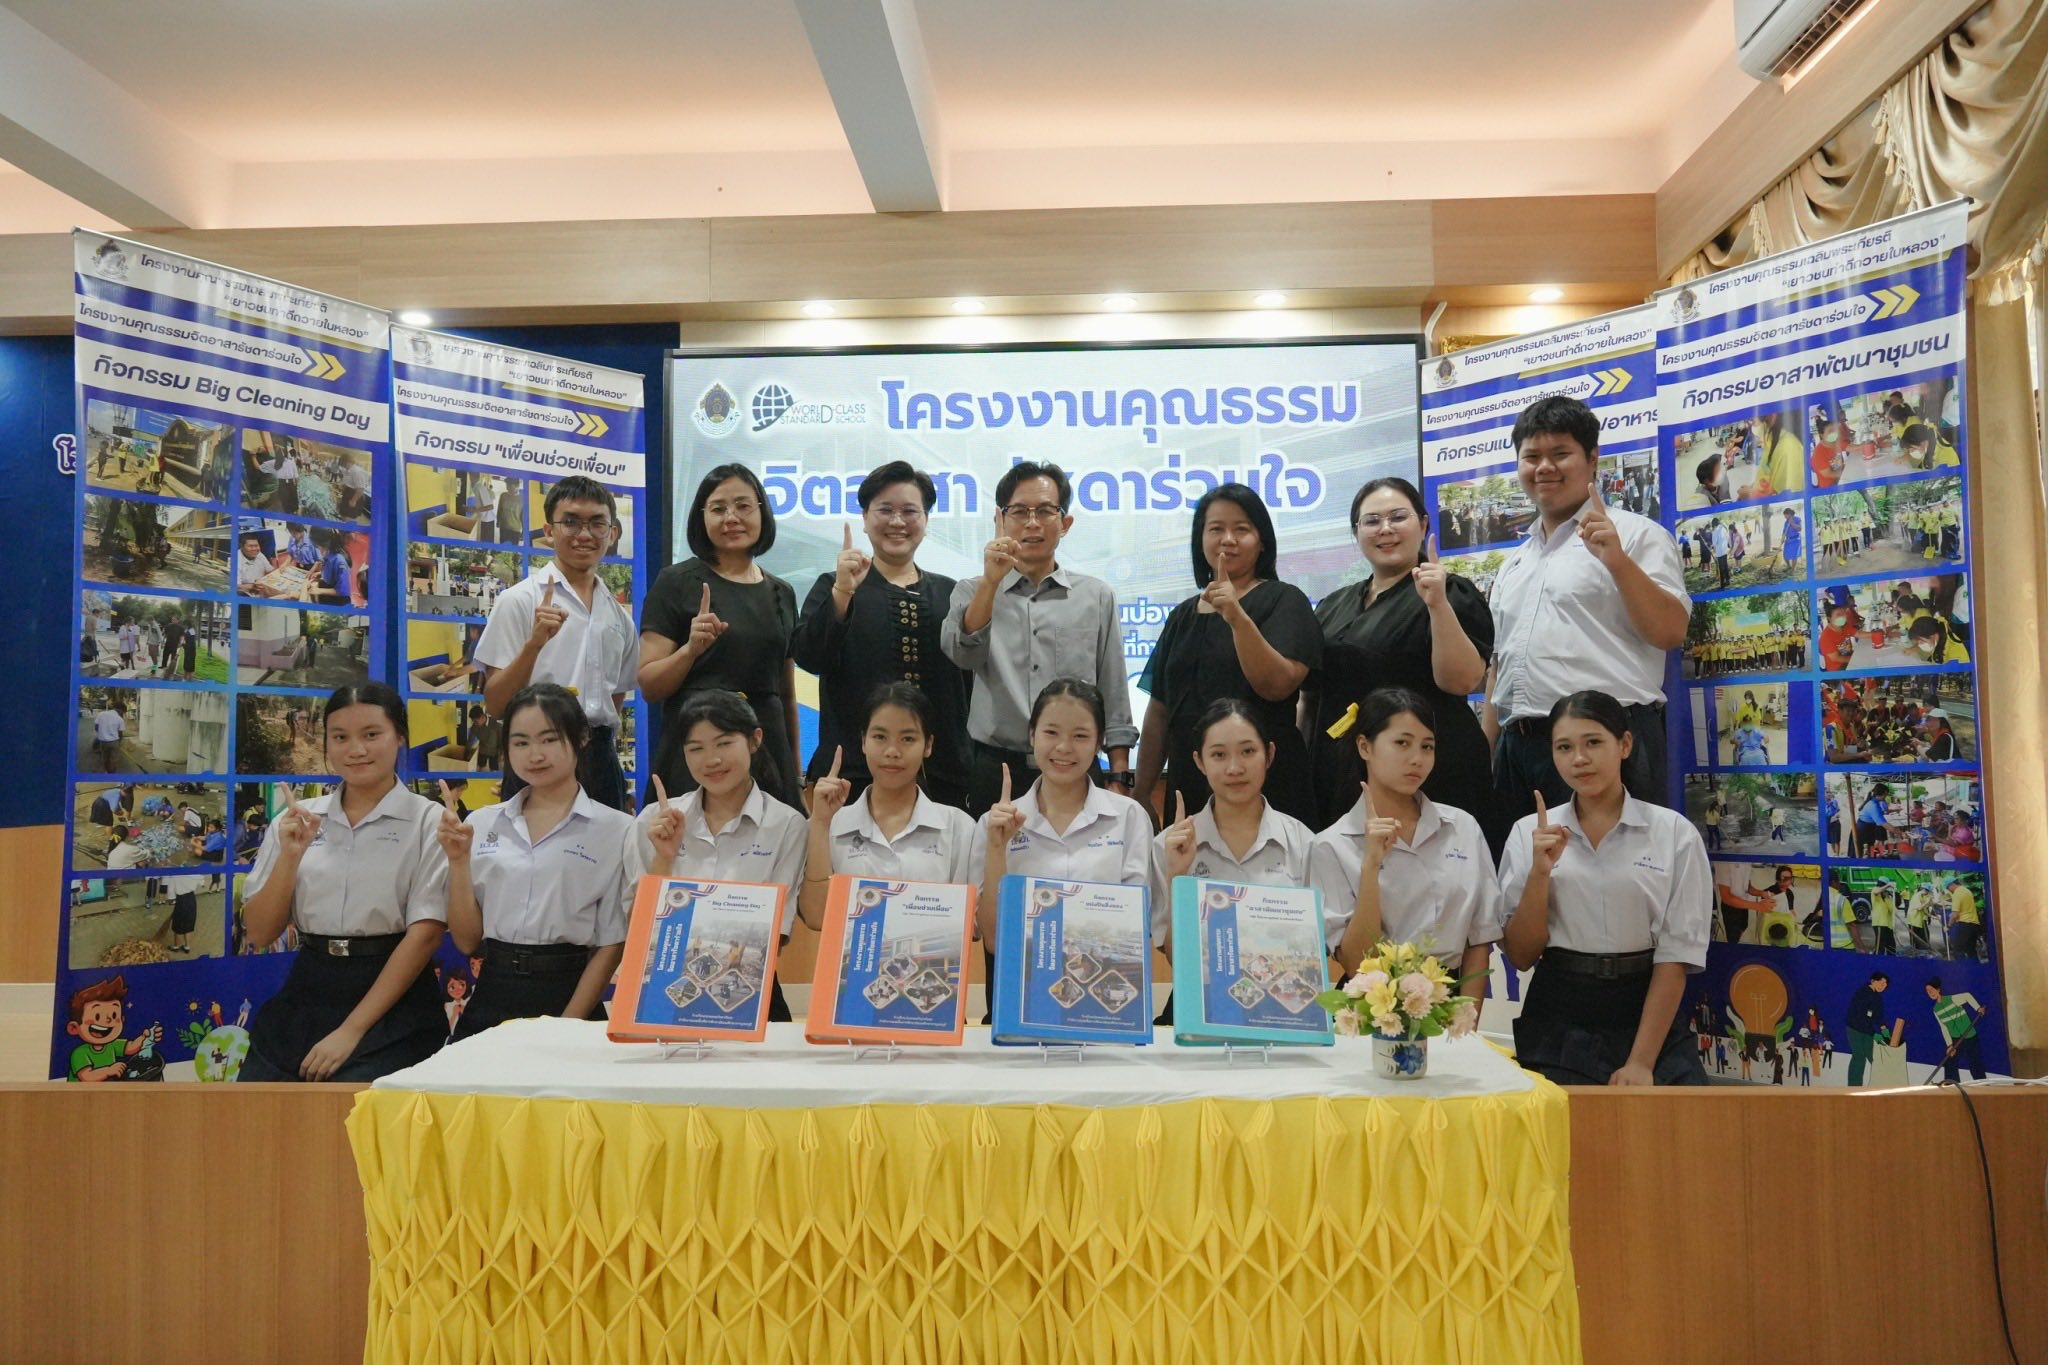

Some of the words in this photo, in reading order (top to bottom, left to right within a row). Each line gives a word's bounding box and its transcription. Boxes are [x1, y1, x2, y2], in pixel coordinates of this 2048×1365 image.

[93, 354, 190, 391] กิจกรรม
[195, 376, 230, 401] Big
[235, 387, 326, 422] Cleaning
[330, 404, 371, 431] Day
[1681, 333, 1950, 409] กิจกรรมอาสาพัฒนาชุมชน
[883, 380, 1357, 442] โครงงานคุณธรรม
[415, 430, 490, 456] กิจกรรม
[764, 465, 978, 516] จิตสา
